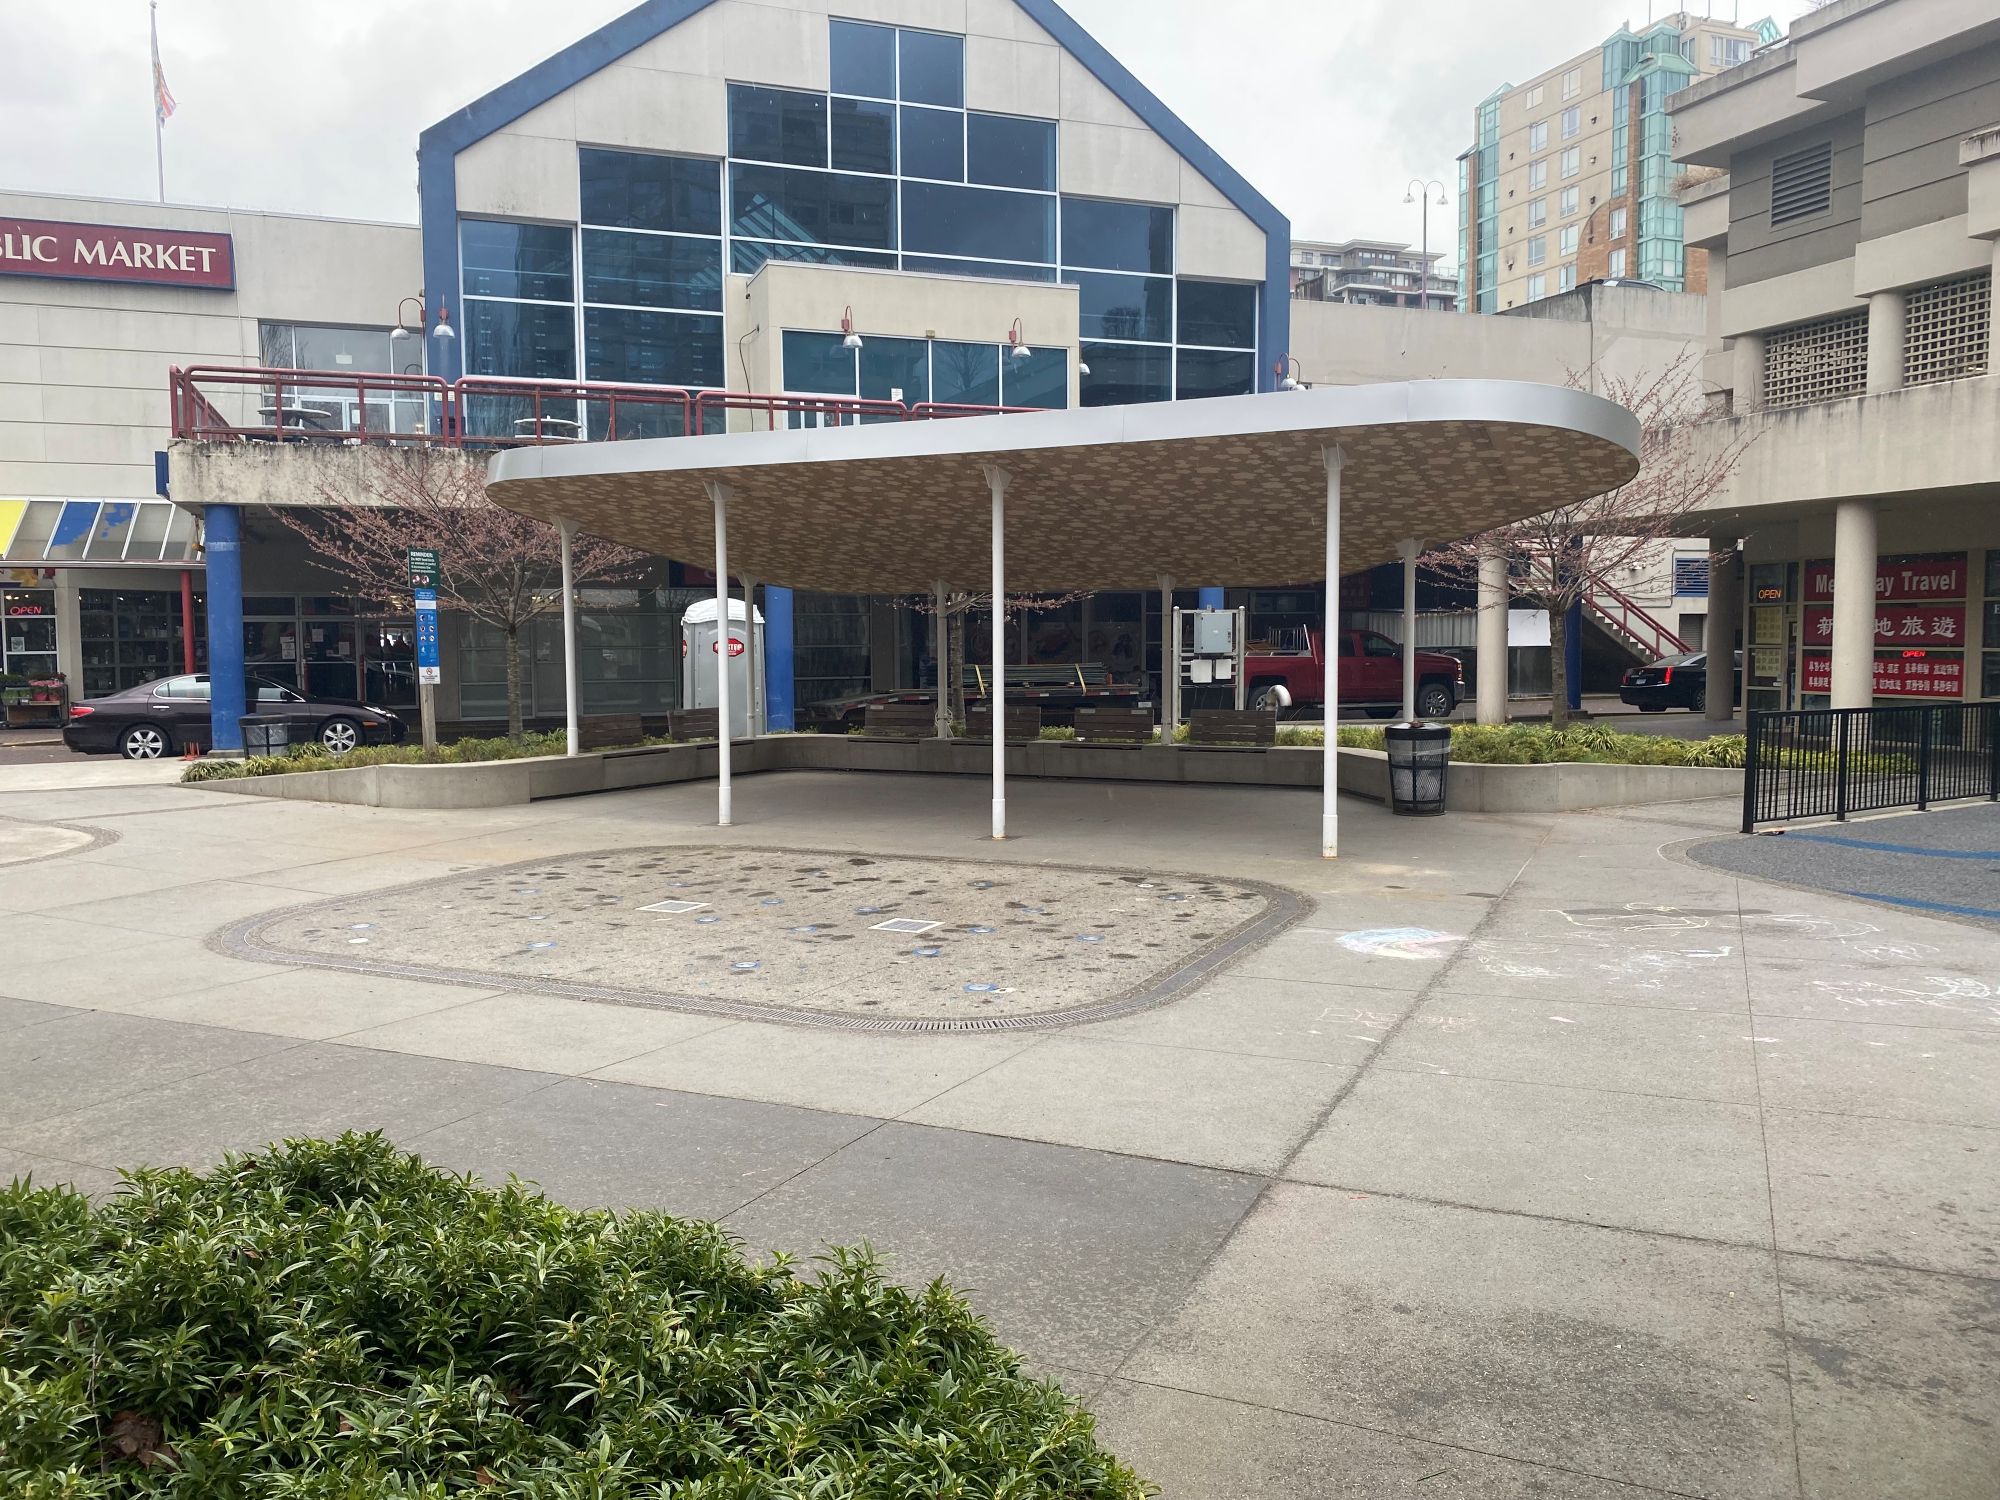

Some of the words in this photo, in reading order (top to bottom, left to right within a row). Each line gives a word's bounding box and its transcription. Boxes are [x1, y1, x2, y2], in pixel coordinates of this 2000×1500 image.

[73, 238, 216, 273] MARKET
[1901, 570, 1956, 591] Travel
[1758, 589, 1781, 599] OPEN
[10, 606, 42, 615] OPEN
